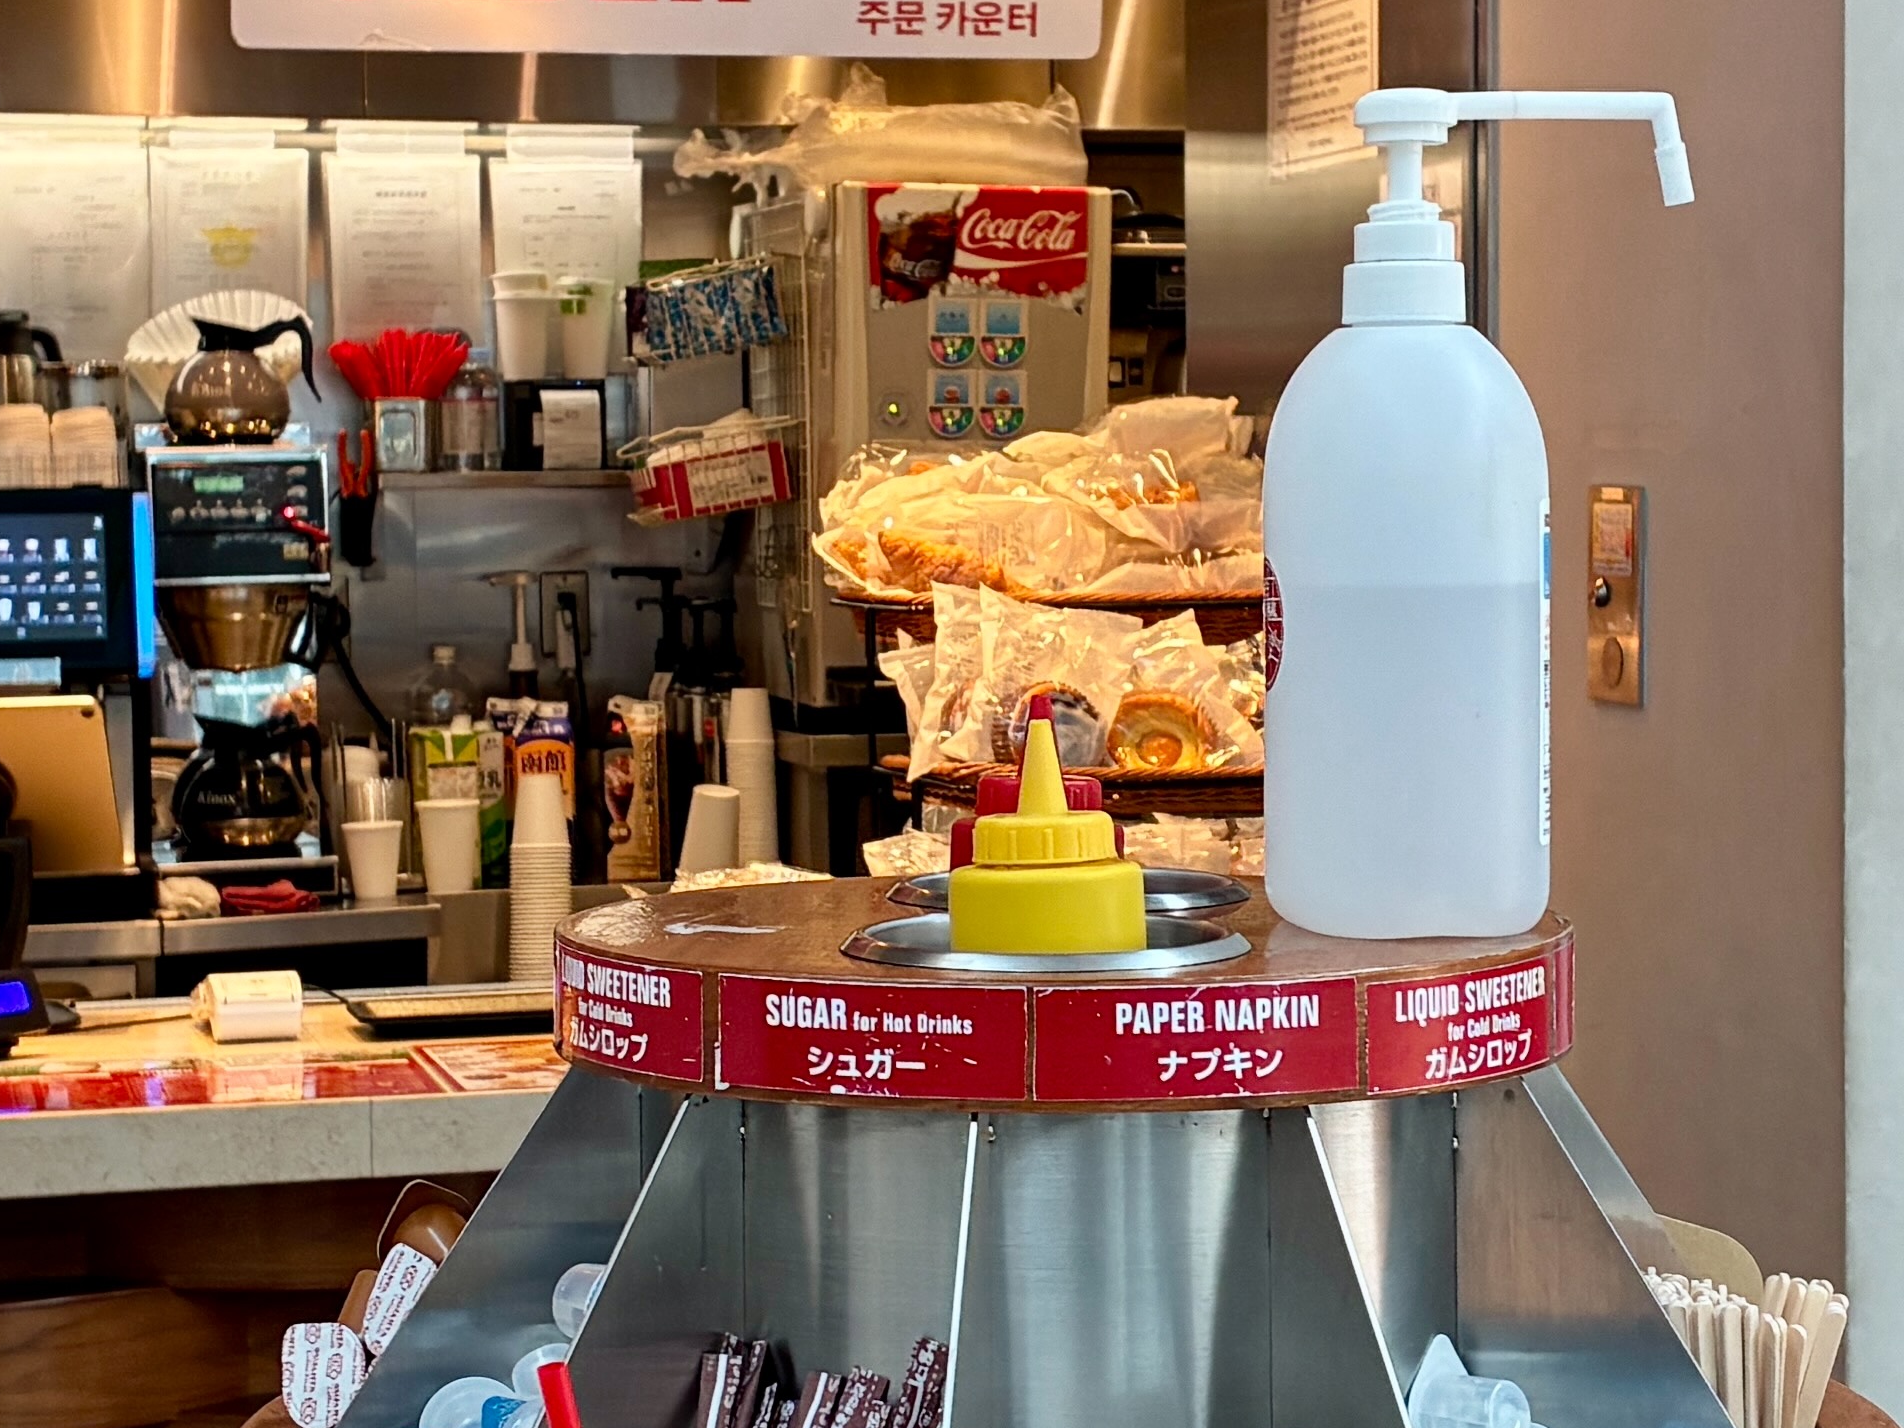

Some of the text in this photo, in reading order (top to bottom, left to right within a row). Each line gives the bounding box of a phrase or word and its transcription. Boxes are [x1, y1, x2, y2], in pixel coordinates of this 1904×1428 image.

[857, 0, 1037, 38] 주문 카운터
[586, 963, 671, 1008] SWEETENER
[1396, 966, 1546, 1024] LIQUID SWEETENER
[765, 994, 973, 1035] SUGAR for Hot Drinks
[1116, 995, 1320, 1035] PAPER NAPKIN
[568, 1018, 647, 1062] ガムシロップ
[1425, 1030, 1532, 1079] ガムシロップ
[807, 1047, 926, 1078] シュガー
[1158, 1043, 1283, 1081] ナプキン
